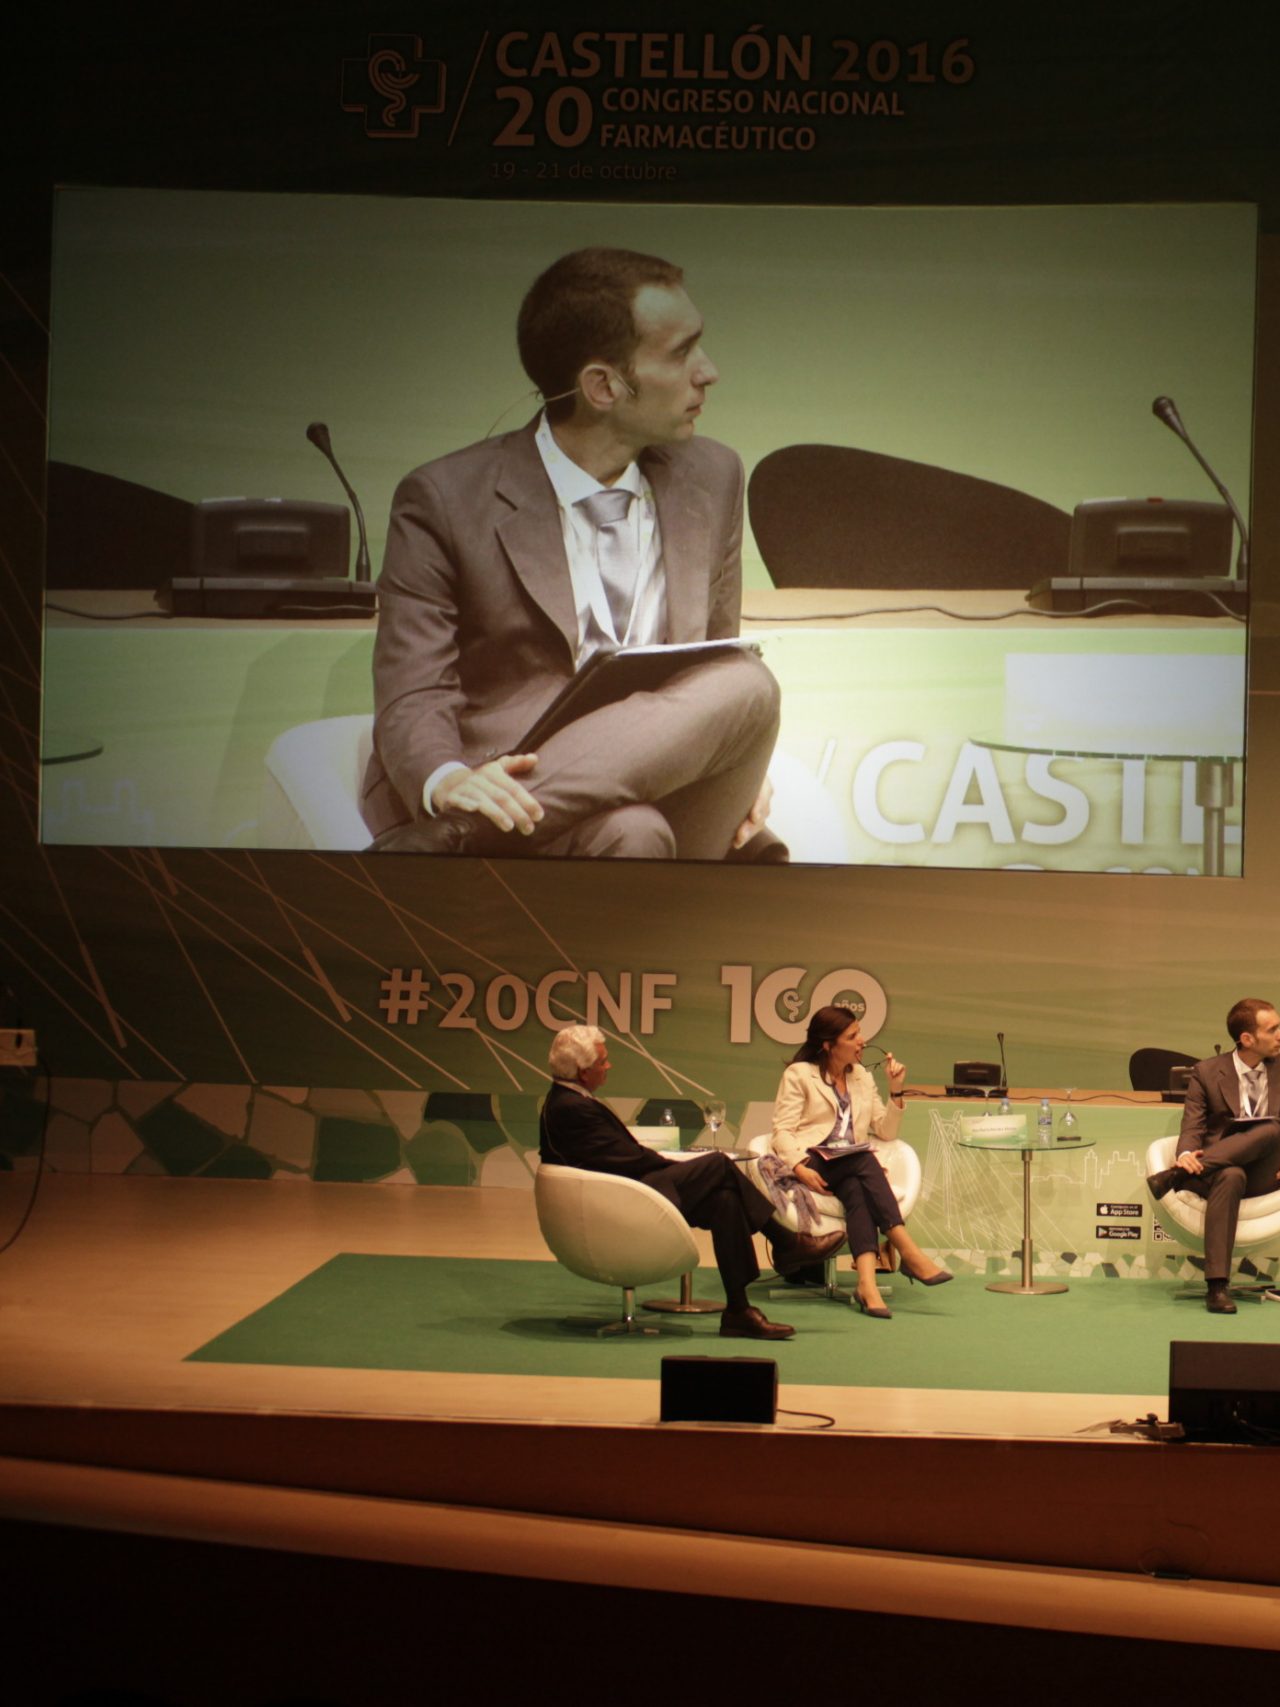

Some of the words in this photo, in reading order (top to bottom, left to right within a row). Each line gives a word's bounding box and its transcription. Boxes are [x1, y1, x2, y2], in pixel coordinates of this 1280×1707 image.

[495, 23, 812, 81] CASTELLÓN
[830, 38, 975, 84] 2016
[491, 86, 594, 149] 20
[602, 87, 755, 115] CONGRESO
[762, 89, 904, 116] NACIONAL
[600, 121, 816, 151] FARMACÉUTICO
[490, 162, 515, 180] 19
[536, 162, 561, 180] 21
[568, 162, 594, 180] de
[601, 162, 678, 182] octubre
[379, 968, 677, 1034] #20CNF
